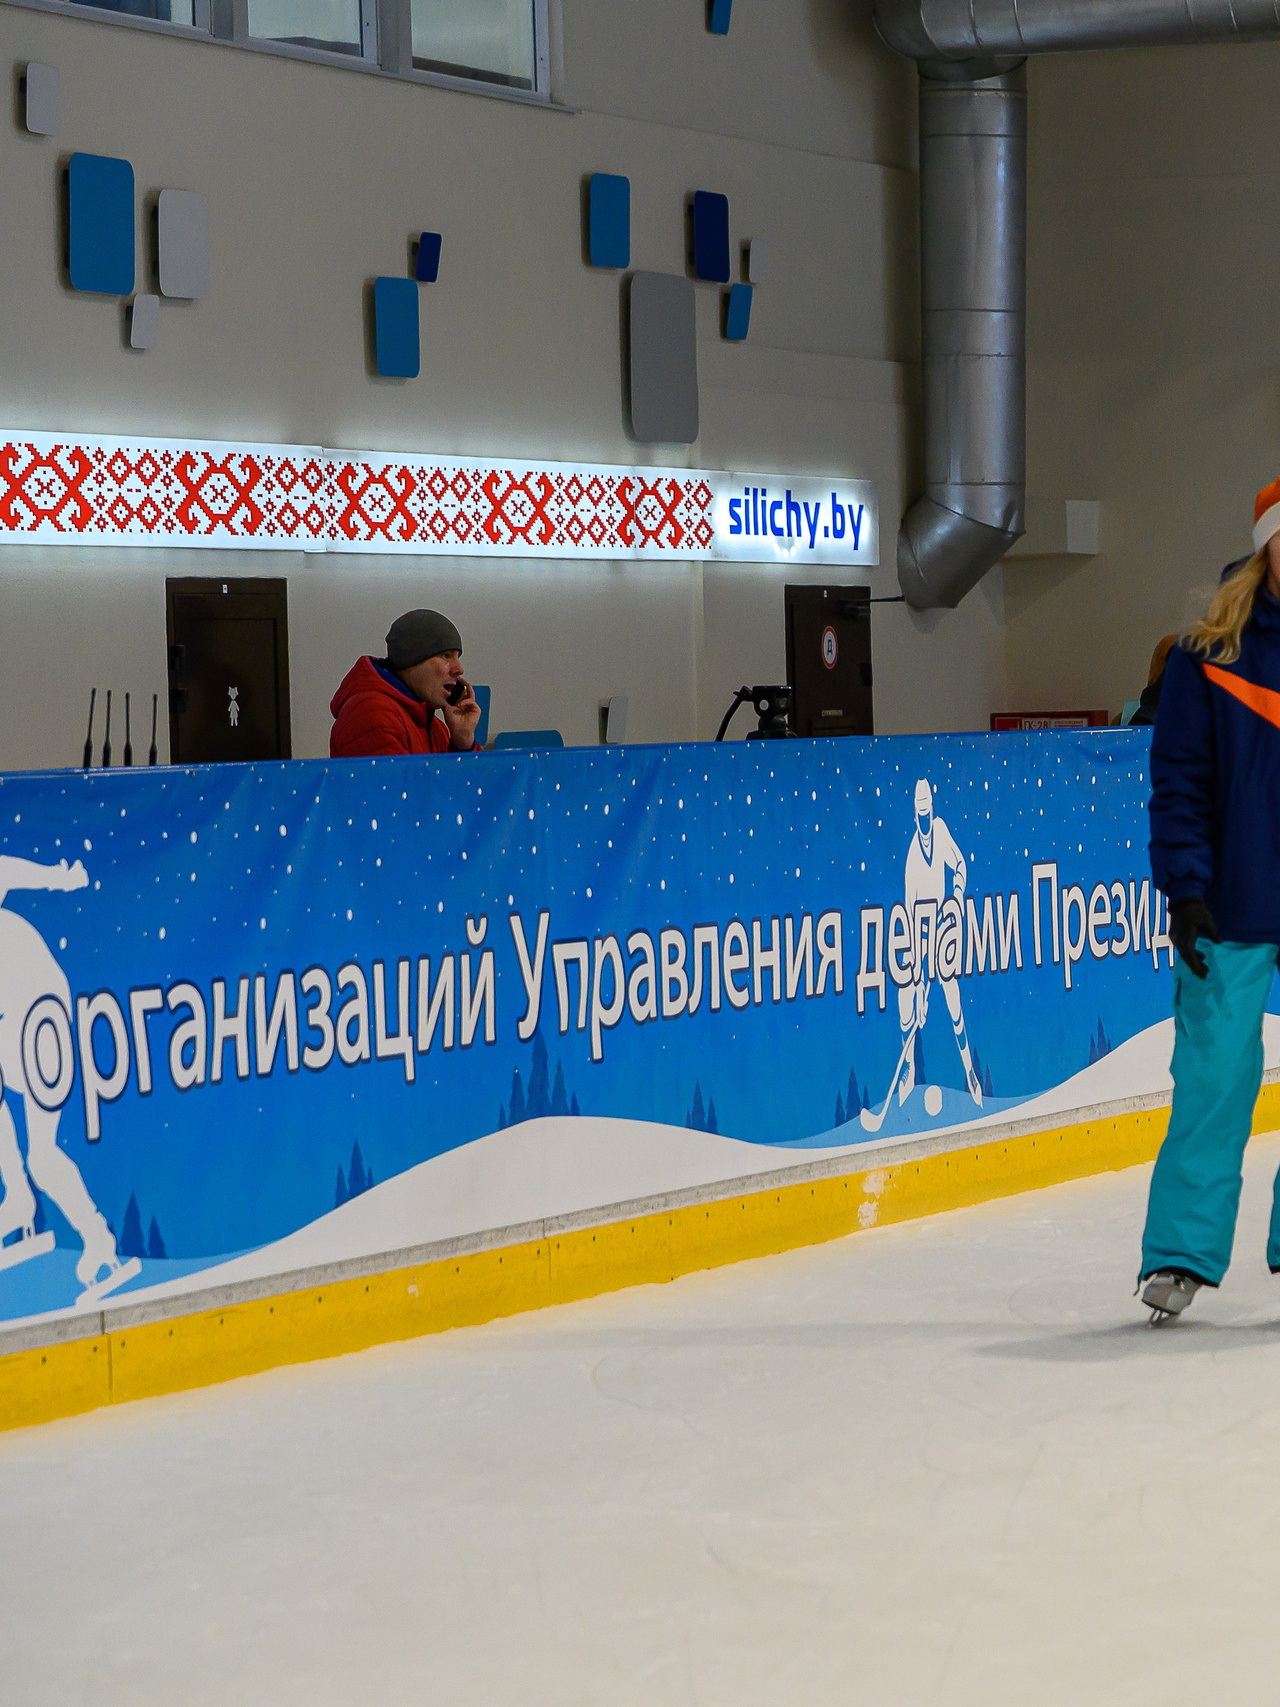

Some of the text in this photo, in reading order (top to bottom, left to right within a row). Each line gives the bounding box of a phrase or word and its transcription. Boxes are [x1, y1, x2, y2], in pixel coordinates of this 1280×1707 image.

[729, 487, 864, 551] silichy.by
[22, 914, 497, 1141] организаций
[509, 906, 844, 1061] Управления
[856, 892, 1022, 1015] делами
